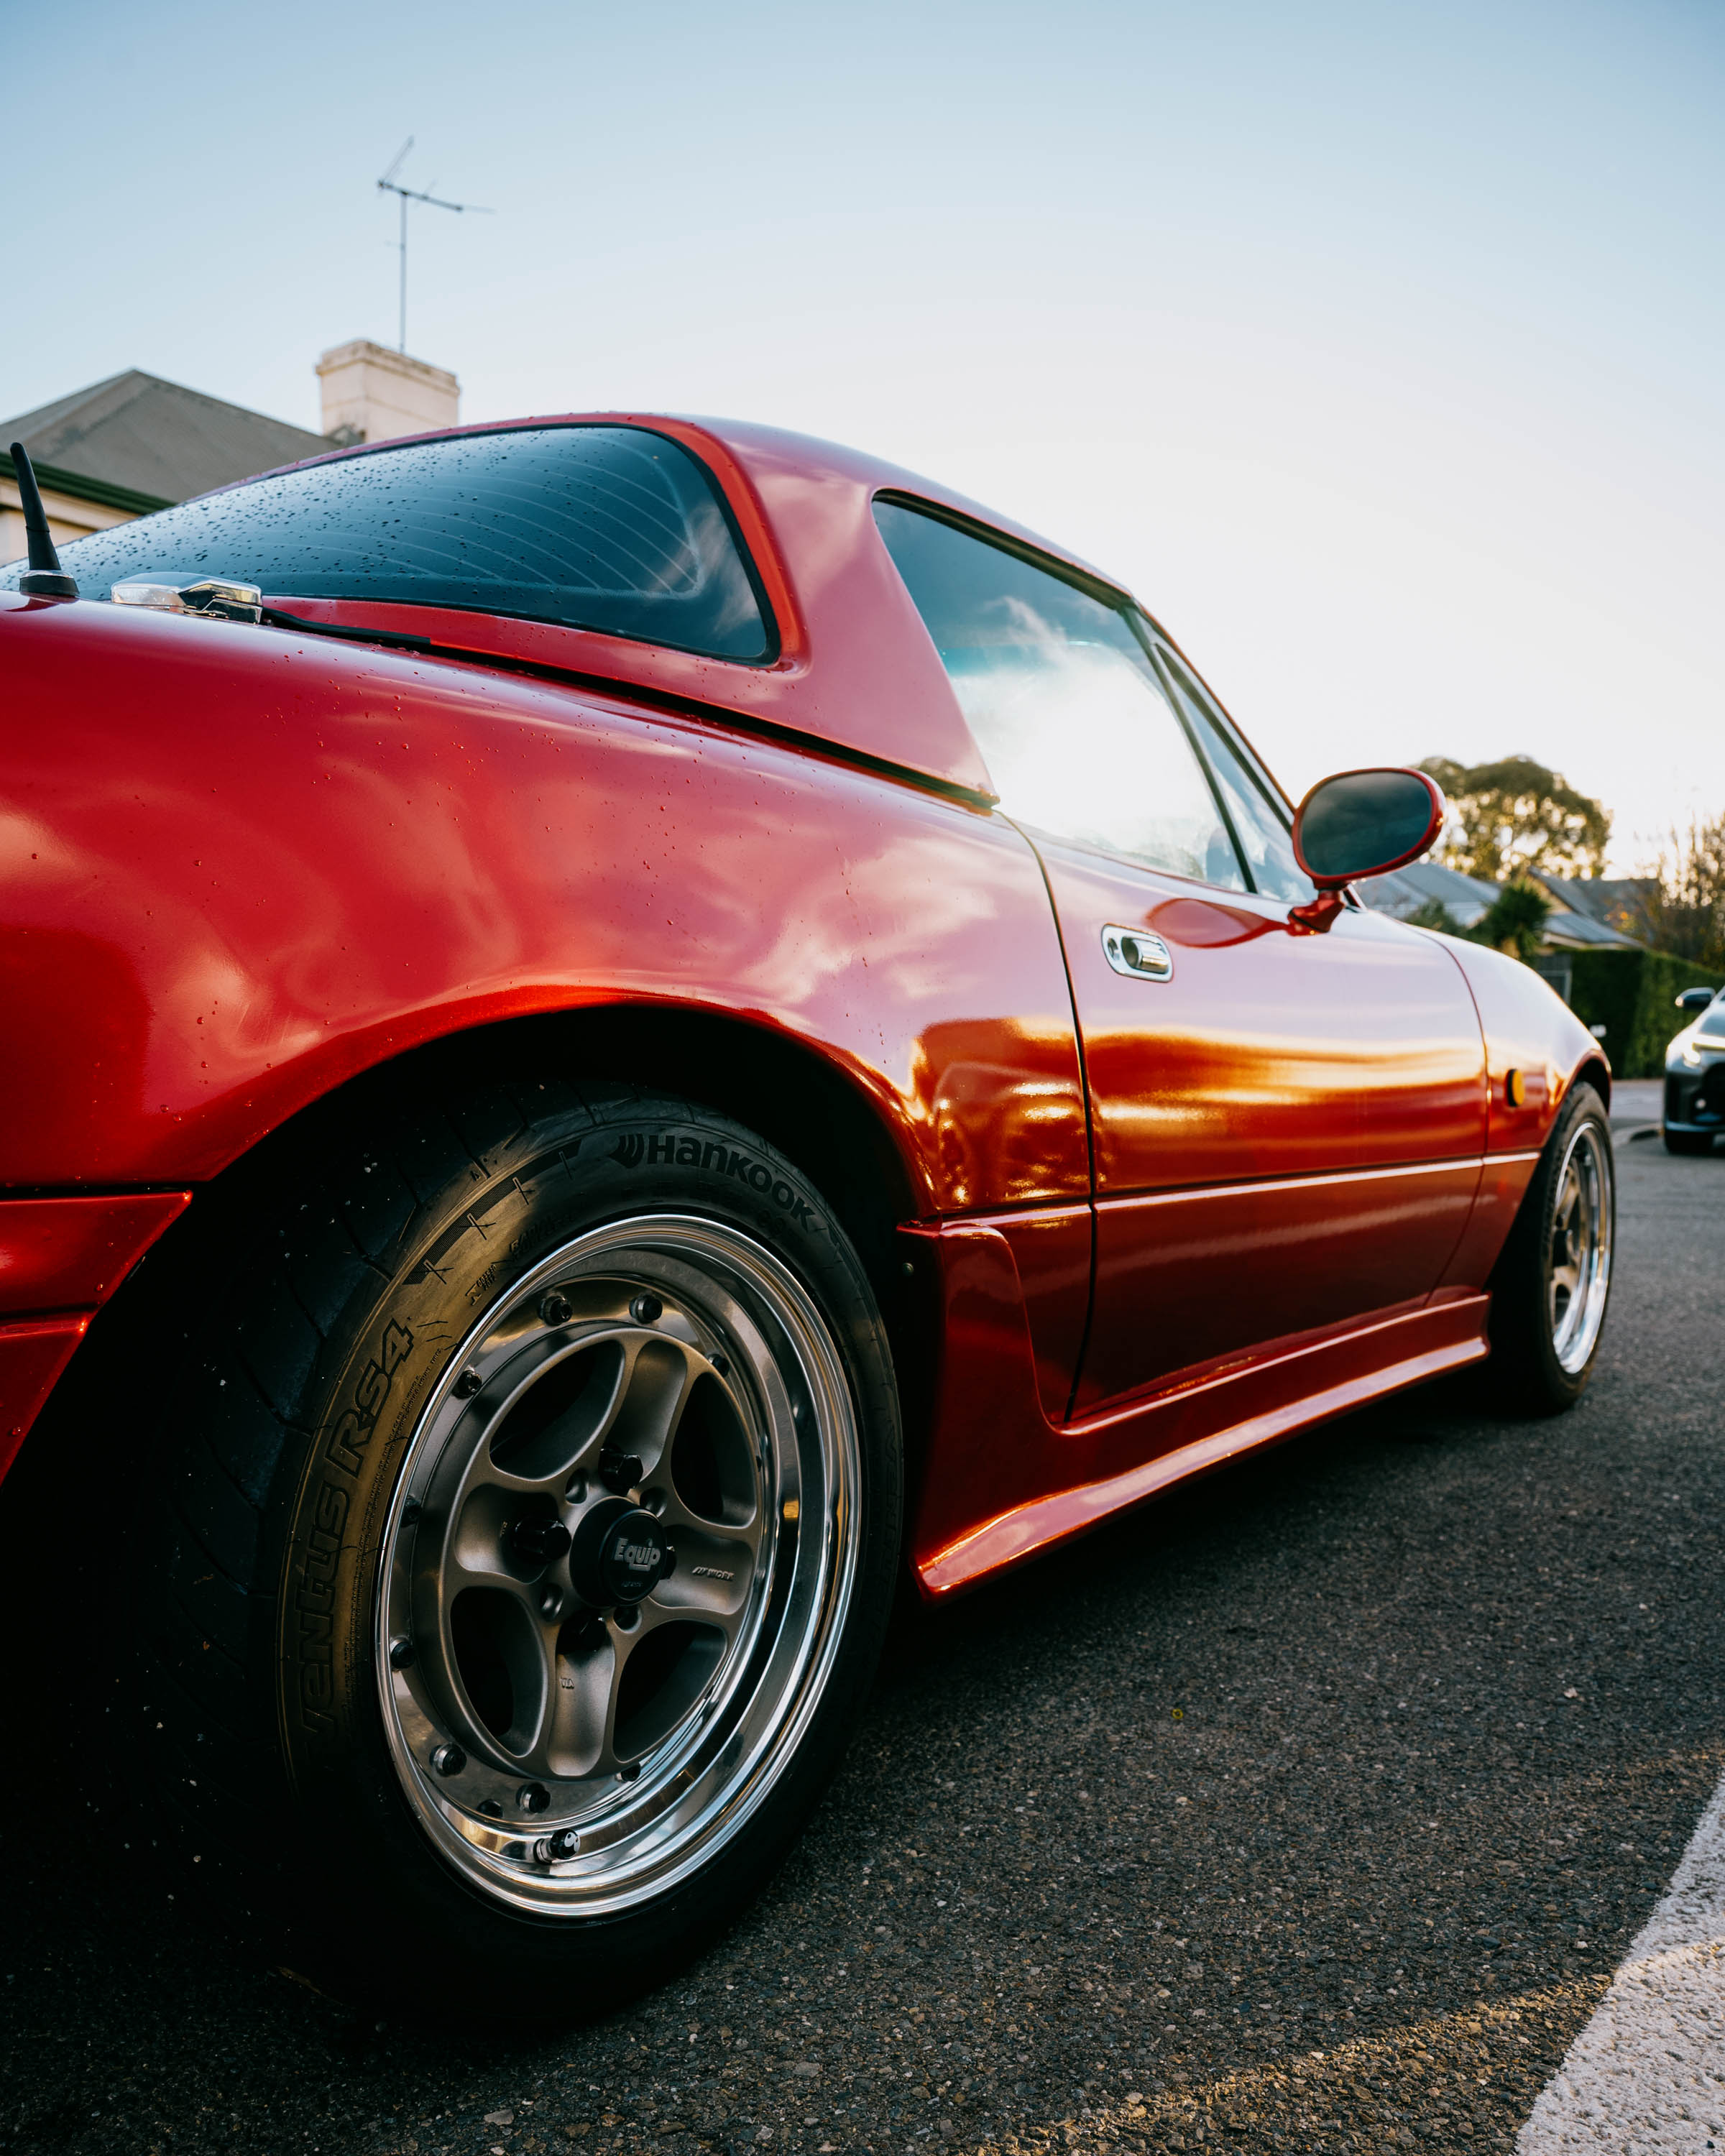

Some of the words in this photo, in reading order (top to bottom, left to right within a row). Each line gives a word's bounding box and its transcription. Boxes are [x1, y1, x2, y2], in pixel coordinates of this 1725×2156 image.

[648, 1135, 815, 1233] Hankook
[324, 1318, 414, 1478] RS4
[614, 1537, 661, 1572] Equip
